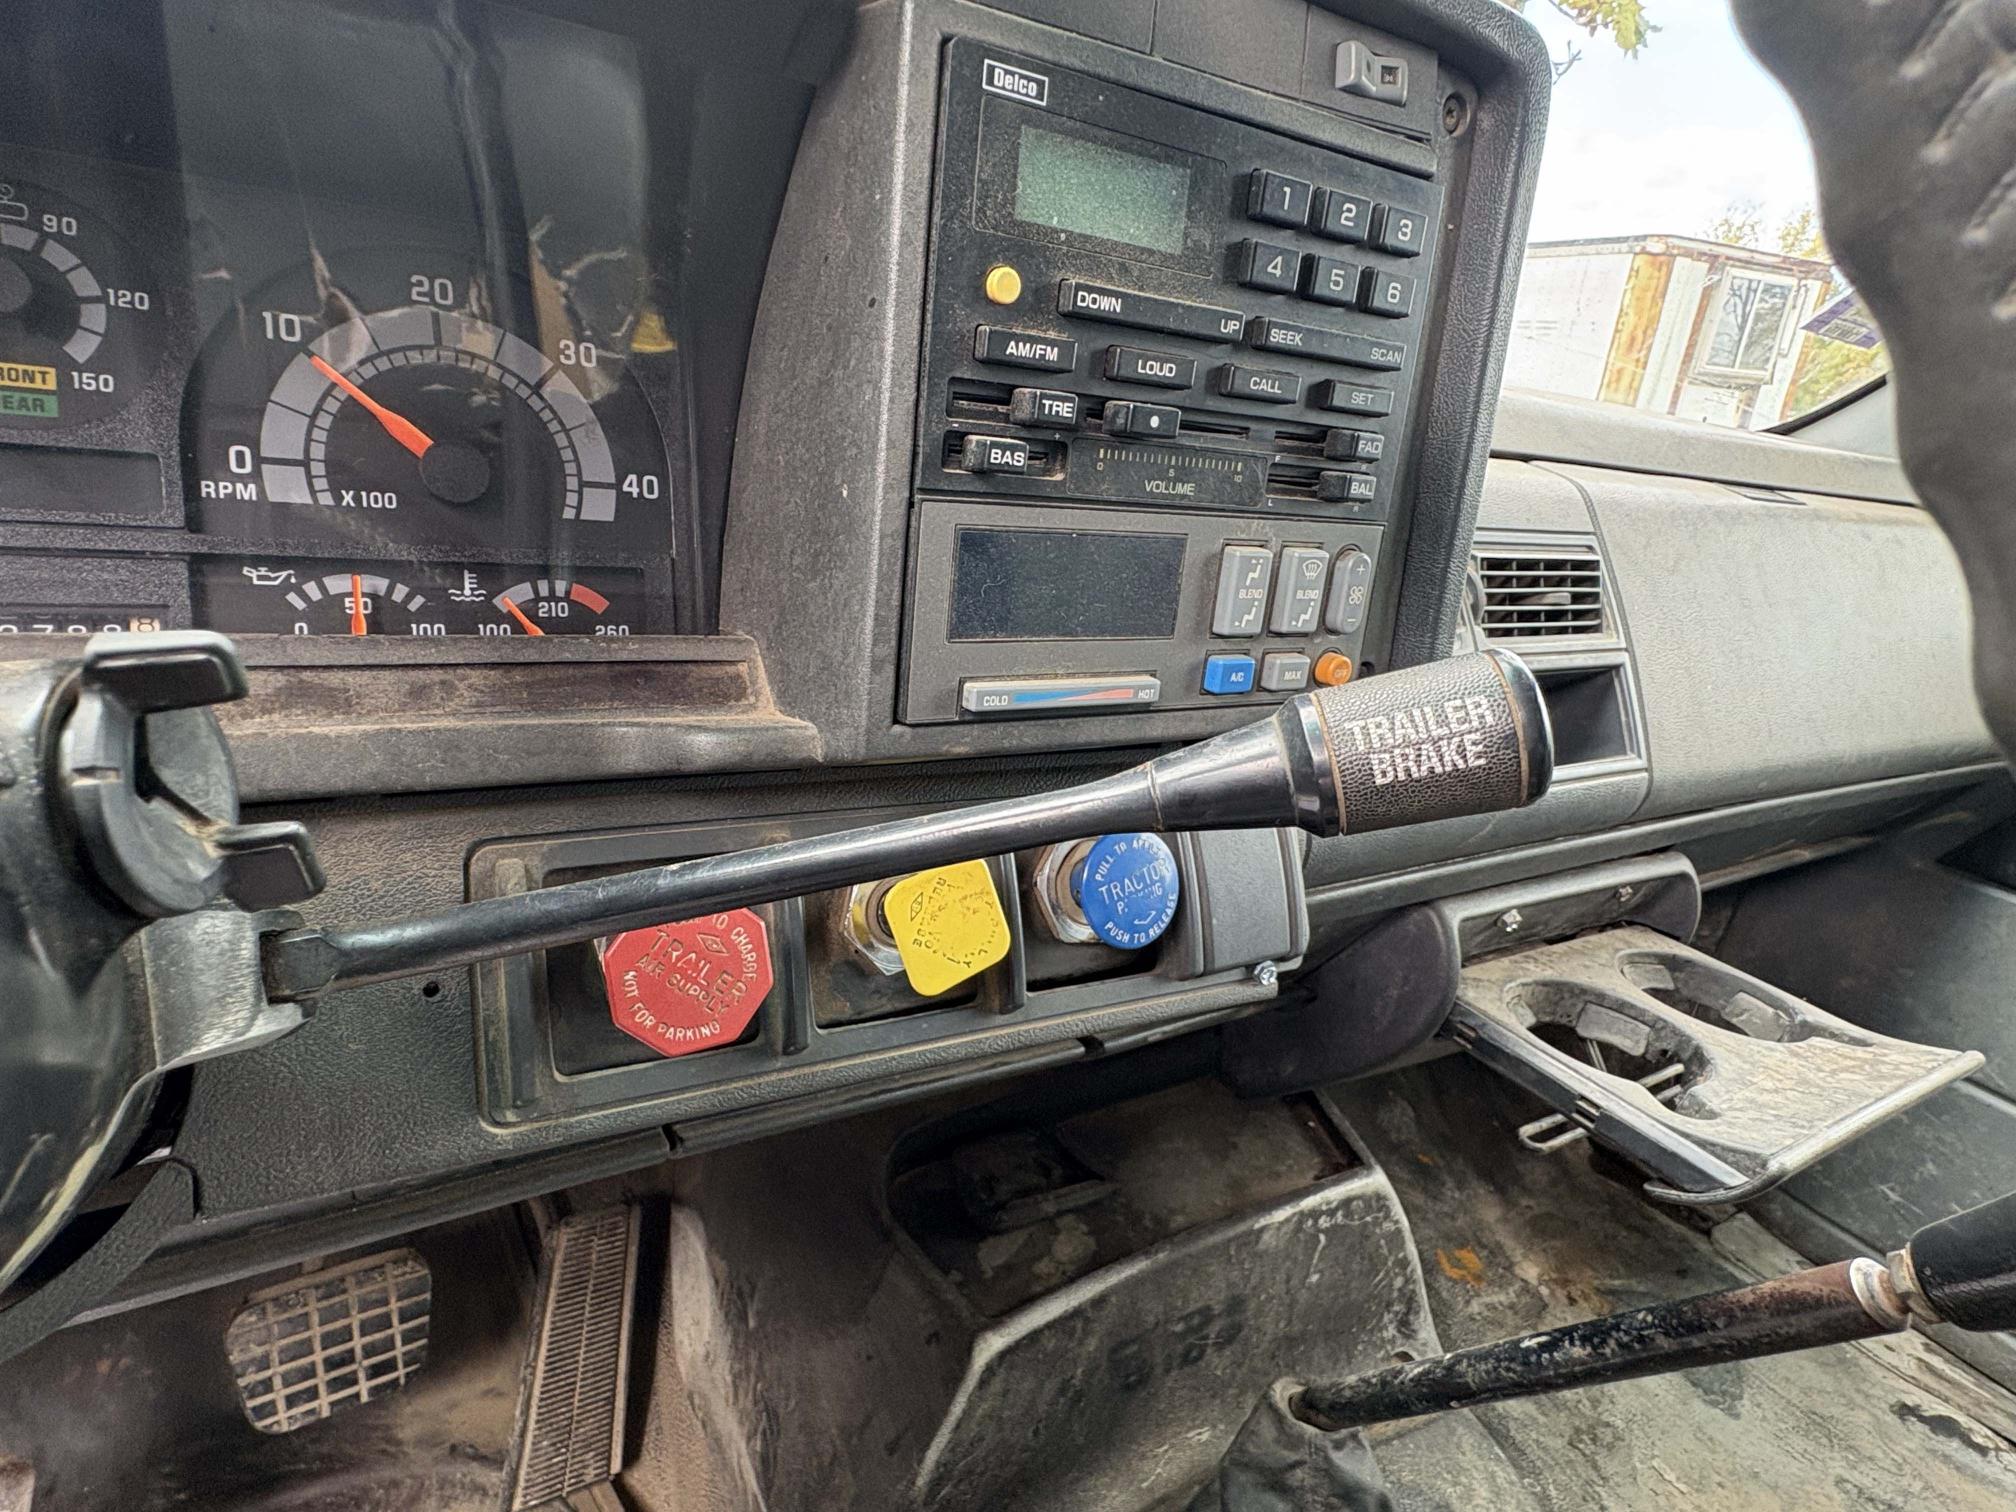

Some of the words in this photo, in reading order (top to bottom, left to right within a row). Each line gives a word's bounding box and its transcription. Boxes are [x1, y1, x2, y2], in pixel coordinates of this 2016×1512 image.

[993, 67, 1037, 97] Delco
[43, 214, 77, 236] 90
[1281, 187, 1292, 211] 1
[1340, 203, 1357, 226] 2
[1398, 219, 1411, 242] 3
[410, 274, 453, 305] 20
[1267, 255, 1282, 278] 4
[1329, 269, 1344, 292] 5
[1387, 282, 1401, 303] 6
[106, 288, 150, 310] 120
[1077, 290, 1122, 314] DOWN
[1220, 319, 1240, 334] UP
[262, 312, 302, 342] 10
[559, 339, 597, 368] 30
[1006, 341, 1059, 363] AM/FM
[1270, 328, 1303, 346] SEEK
[1371, 347, 1403, 363] SCAN
[1137, 358, 1177, 378] LOUD
[71, 371, 114, 393] 150
[1249, 376, 1282, 394] CALL
[1042, 400, 1073, 419] TRE
[1351, 391, 1374, 407] SET
[990, 448, 1025, 467] BAS
[1358, 440, 1381, 454] FAD
[229, 445, 252, 474] 0
[200, 480, 257, 501] RPM
[622, 474, 659, 499] 40
[1144, 479, 1195, 496] VOLUME
[1350, 482, 1373, 496] BAL
[1239, 589, 1263, 599] BLEND
[1296, 589, 1319, 599] BLEND
[344, 597, 372, 614] 50
[538, 602, 569, 617] 210
[411, 623, 446, 635] 100
[478, 624, 511, 635] 100
[1230, 671, 1245, 682] A/C
[1284, 671, 1303, 681] MAX
[983, 694, 1009, 707] COLD
[1138, 688, 1156, 700] HOT
[1345, 695, 1495, 752] TRAILER
[1370, 733, 1488, 787] BRAKE
[1095, 855, 1115, 882] PULL
[1113, 842, 1127, 855] TO
[1098, 858, 1170, 905] TRACTOR
[1104, 921, 1130, 944] PUSH
[1133, 933, 1146, 944] TO
[1149, 893, 1176, 939] RELEASE
[730, 927, 757, 983] CHARGE
[650, 929, 748, 1005] TRAILER
[622, 970, 640, 998] NOT
[636, 953, 665, 980] AIR
[667, 973, 730, 1017] SUPPLY
[630, 1002, 656, 1029] FOR
[657, 1020, 720, 1041] PARKING
